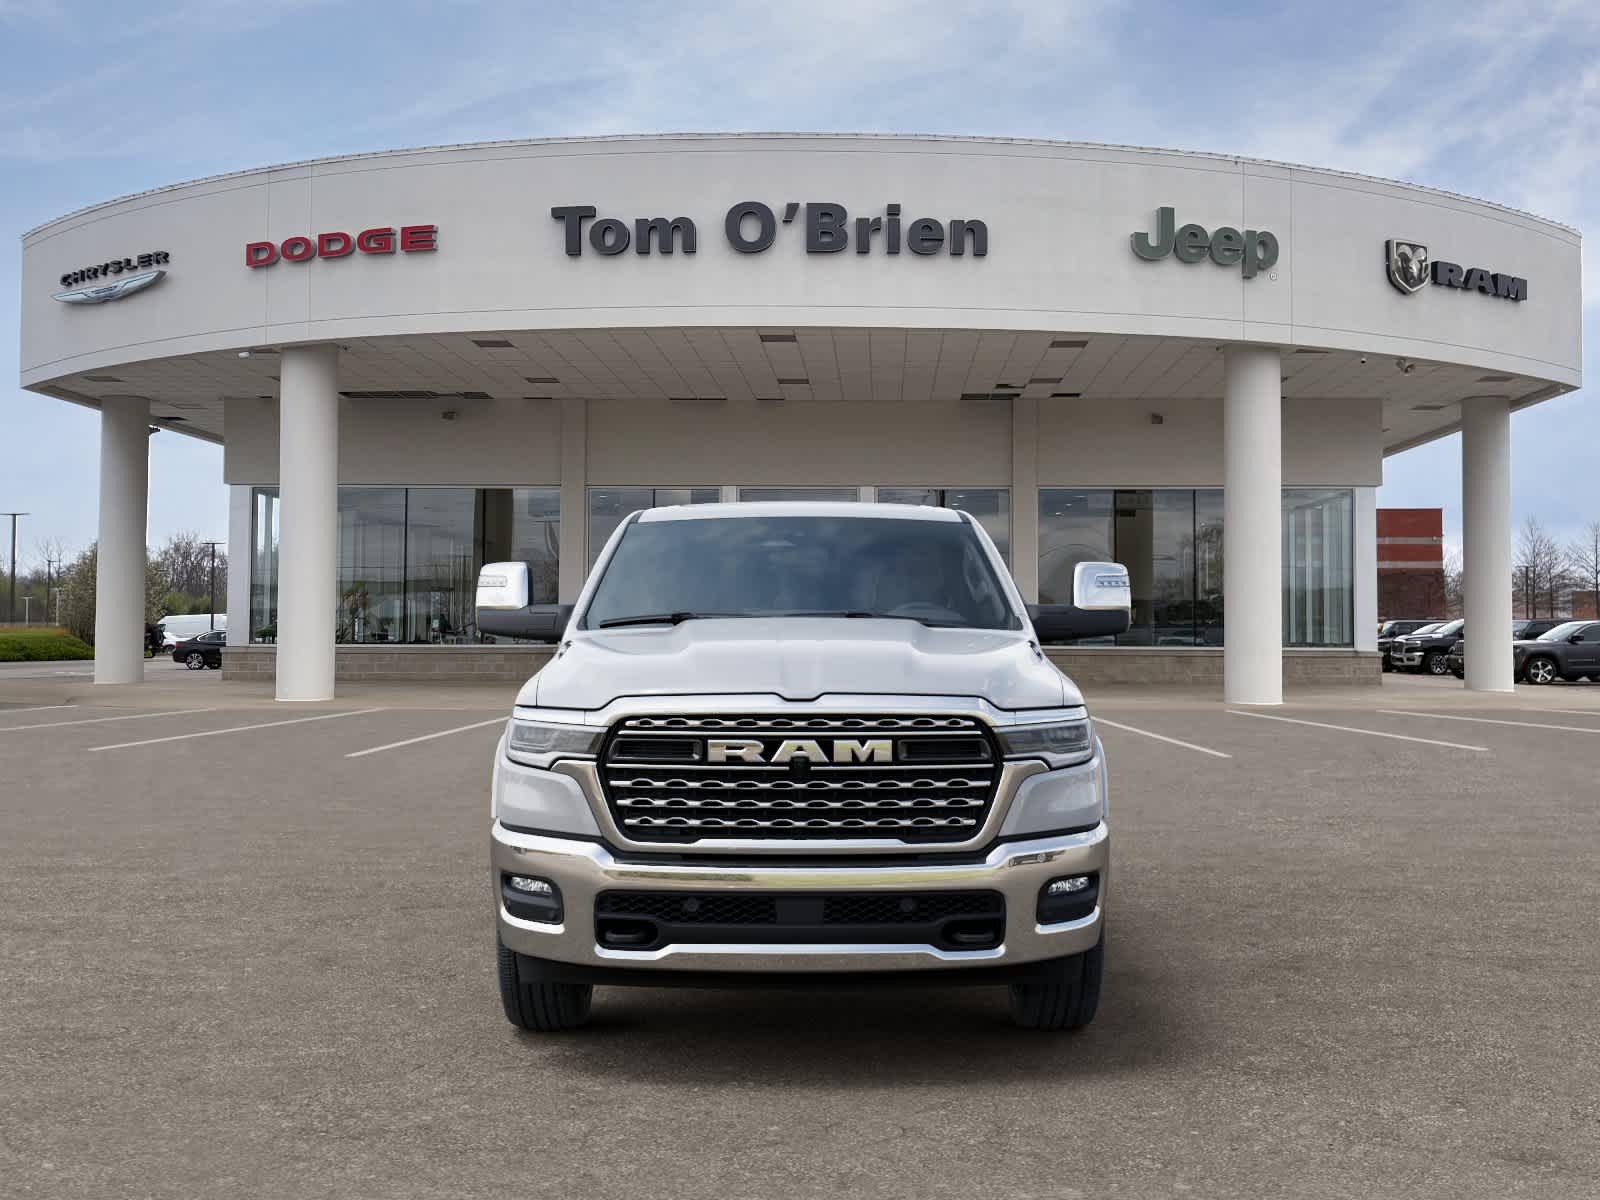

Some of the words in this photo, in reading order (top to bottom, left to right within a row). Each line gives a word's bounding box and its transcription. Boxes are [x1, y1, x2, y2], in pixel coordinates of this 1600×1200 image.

[246, 225, 437, 268] DODGE
[551, 206, 697, 256] Tom
[725, 201, 988, 256] O'Brien
[1130, 207, 1279, 279] Jeep
[60, 251, 169, 287] CHRYSLER
[1431, 260, 1528, 301] RAM
[707, 739, 893, 763] RAM
